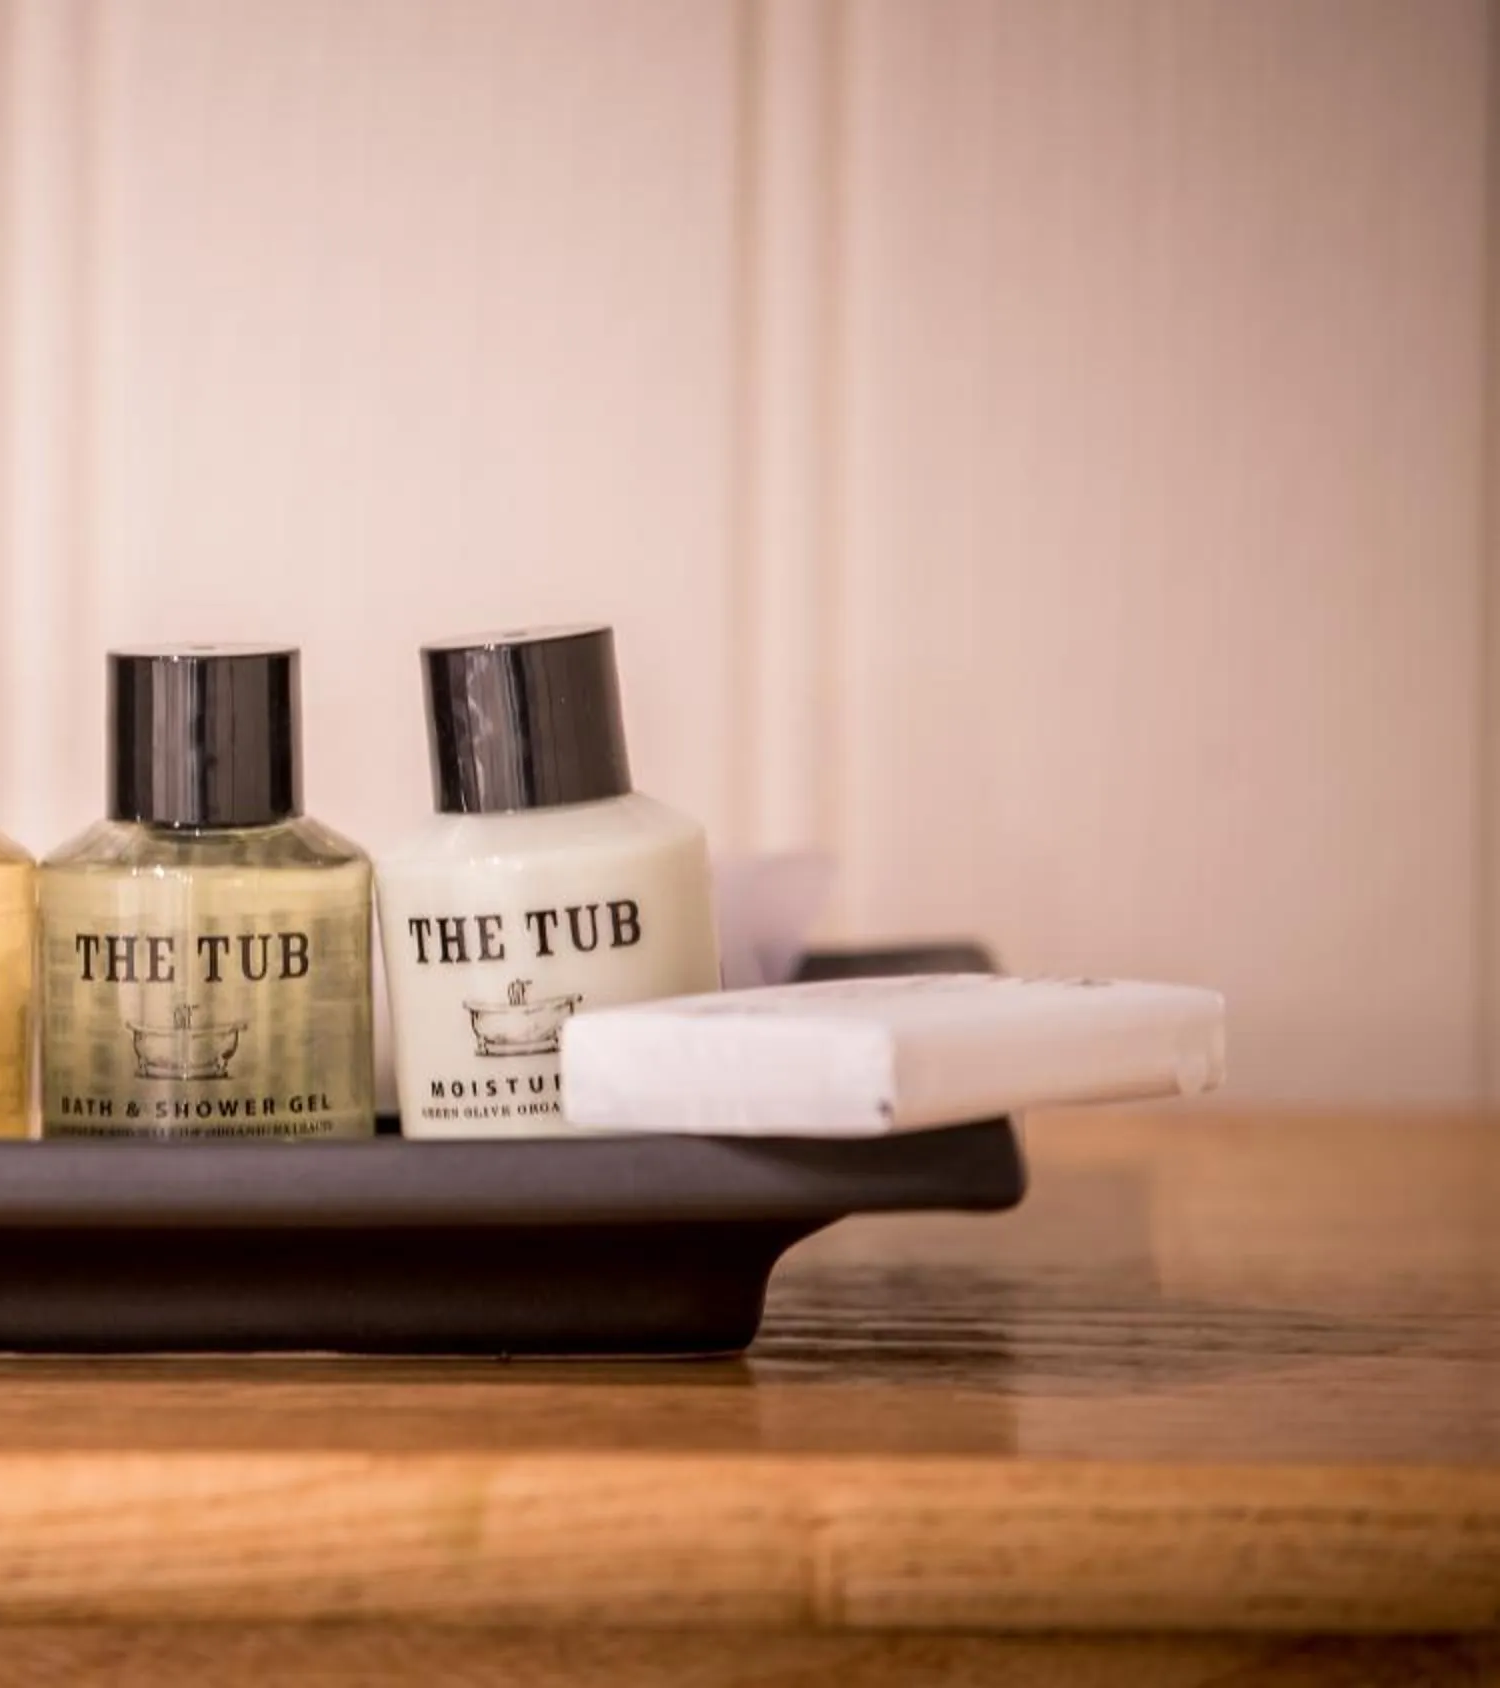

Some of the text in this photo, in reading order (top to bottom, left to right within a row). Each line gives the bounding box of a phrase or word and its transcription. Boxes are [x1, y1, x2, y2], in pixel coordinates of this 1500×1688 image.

[409, 899, 642, 964] THE TUB
[76, 932, 310, 983] THE TUB
[61, 1094, 332, 1119] BATH & SHOWER GEL
[463, 1104, 511, 1119] OLIVE
